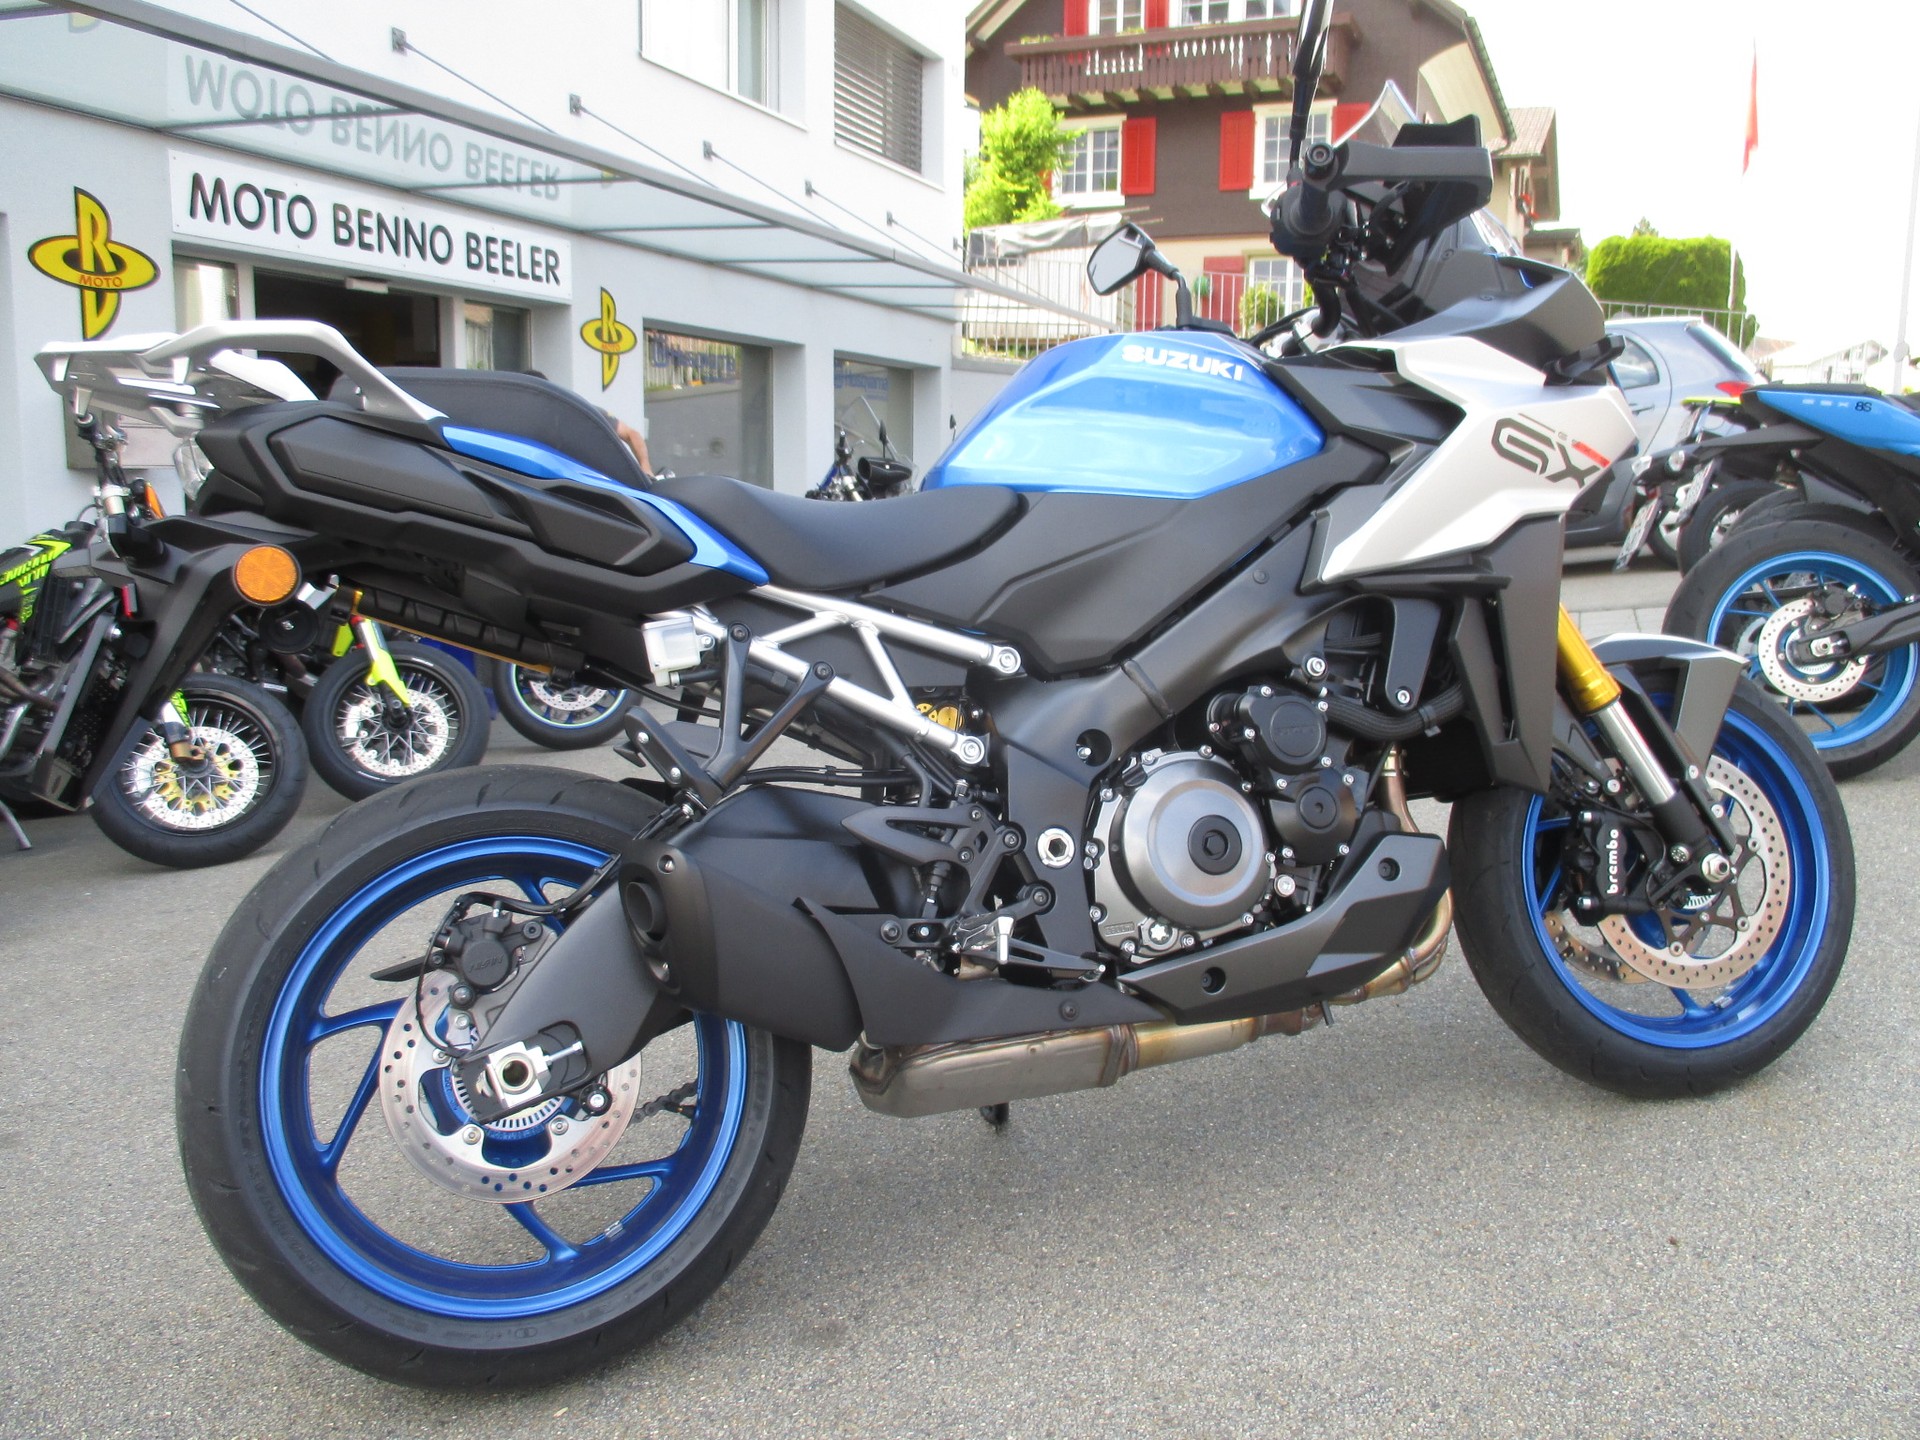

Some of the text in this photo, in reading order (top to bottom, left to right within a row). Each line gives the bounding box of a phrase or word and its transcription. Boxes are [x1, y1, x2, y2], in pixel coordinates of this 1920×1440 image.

[189, 172, 561, 286] MOTO BENNO BEELER
[79, 274, 123, 288] MOTO
[1121, 344, 1243, 381] SUZUKI
[1854, 401, 1873, 413] 8S
[1606, 828, 1619, 894] brembo
